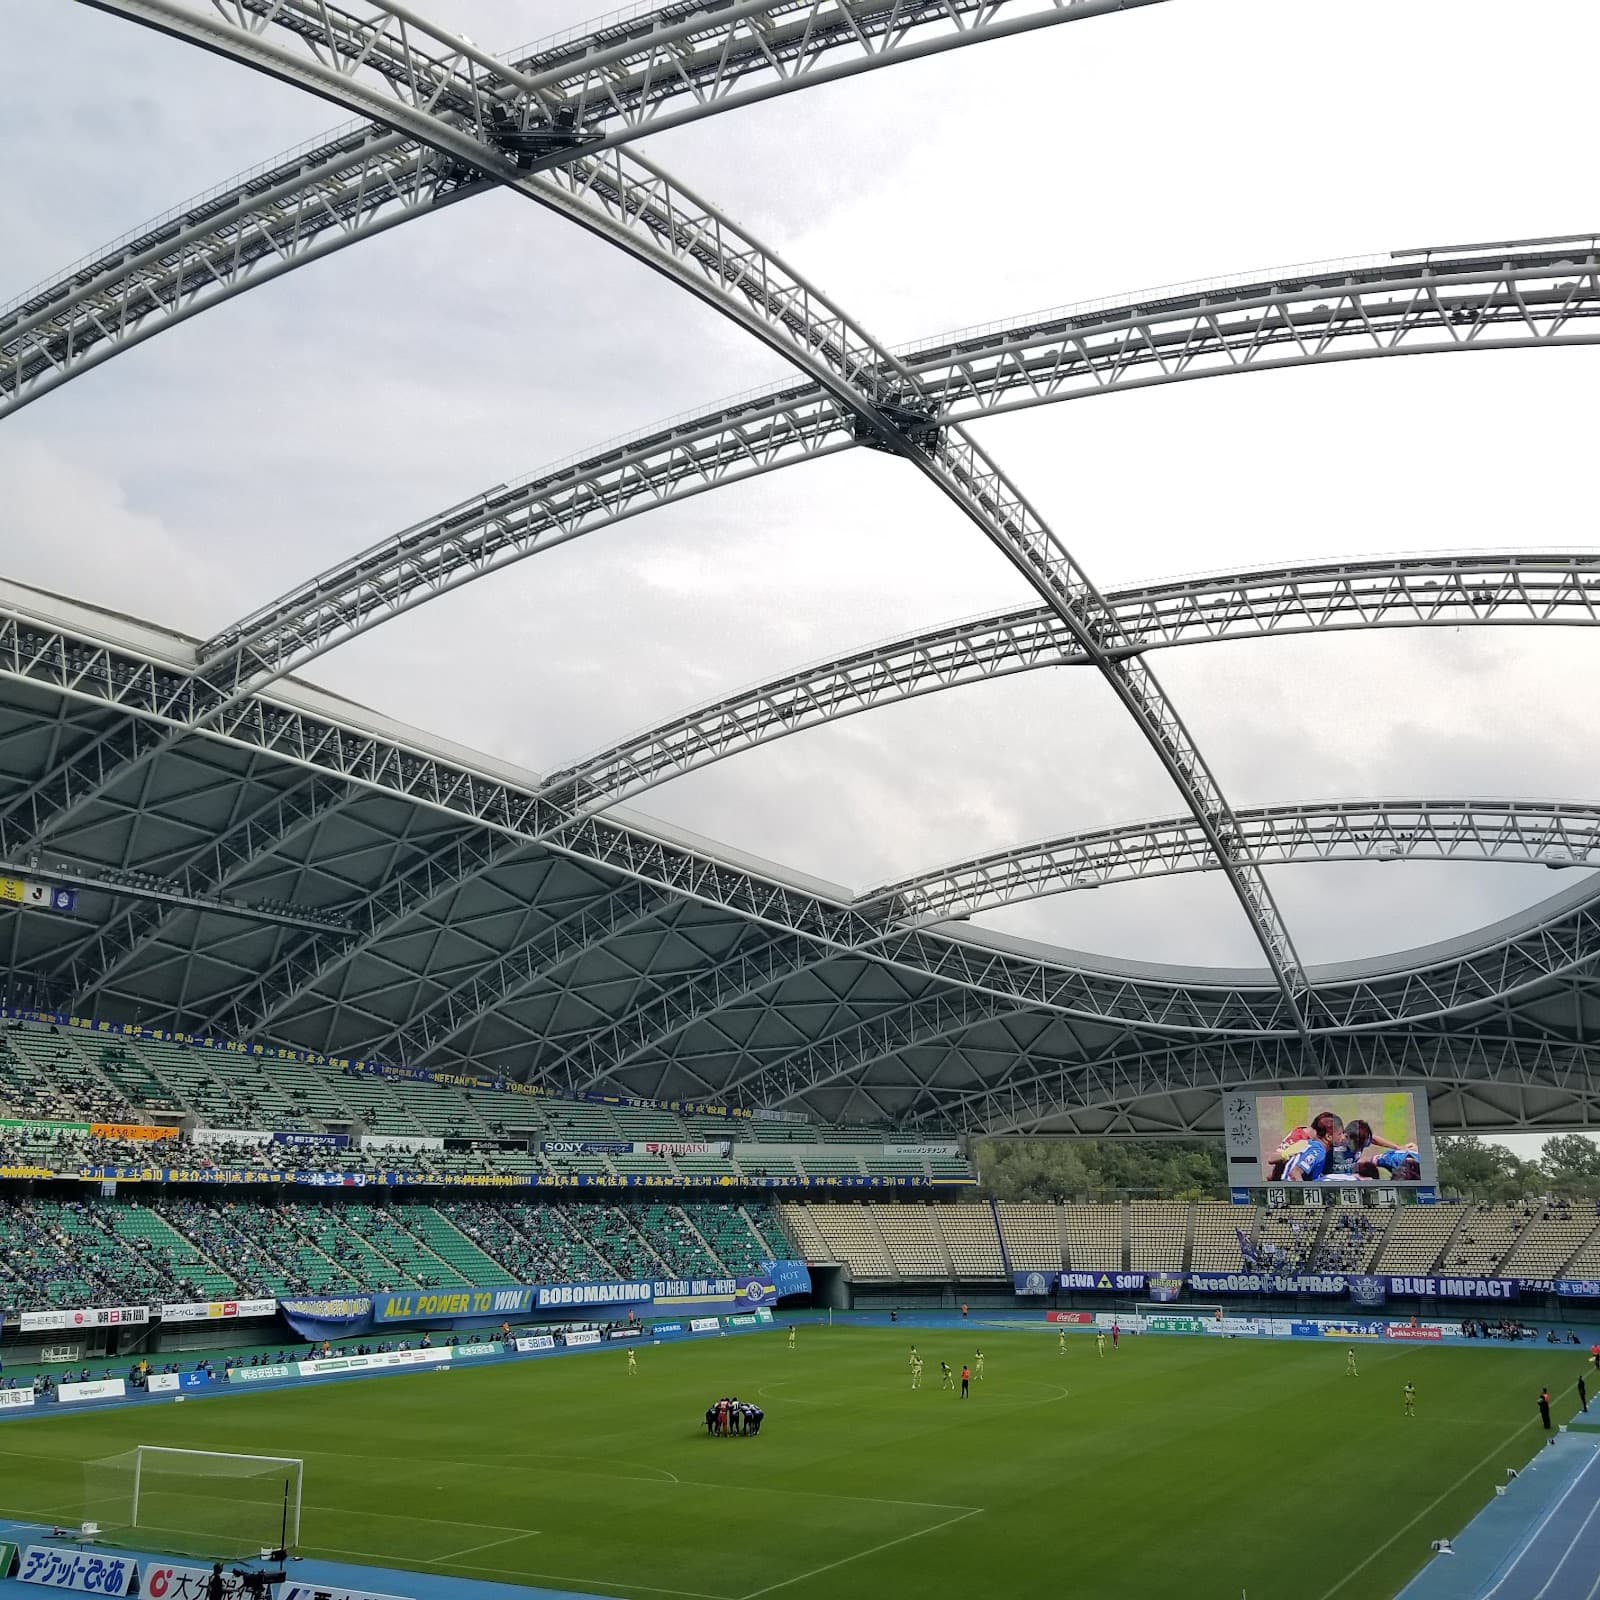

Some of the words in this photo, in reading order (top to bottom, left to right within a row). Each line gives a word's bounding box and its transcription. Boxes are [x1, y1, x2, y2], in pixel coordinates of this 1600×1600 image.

[544, 1142, 584, 1152] SONY
[660, 1143, 710, 1154] DAIHATSU
[1269, 1188, 1397, 1204] 昭和電工
[779, 1271, 800, 1281] NOT
[1061, 1273, 1095, 1288] DEWA
[1275, 1275, 1345, 1293] ULTRAS
[538, 1283, 651, 1305] BOBOMAXIMO
[666, 1279, 690, 1296] AHEAD
[715, 1279, 737, 1294] NEVER
[778, 1282, 809, 1297] ALONE
[1391, 1277, 1437, 1295] BLUE
[1440, 1279, 1513, 1298] IMPACT
[384, 1296, 413, 1318] ALL
[415, 1293, 469, 1316] POWER
[473, 1292, 492, 1312] TO
[97, 1309, 144, 1324] 朝日新聞
[23, 1551, 126, 1593] チケットぴあ
